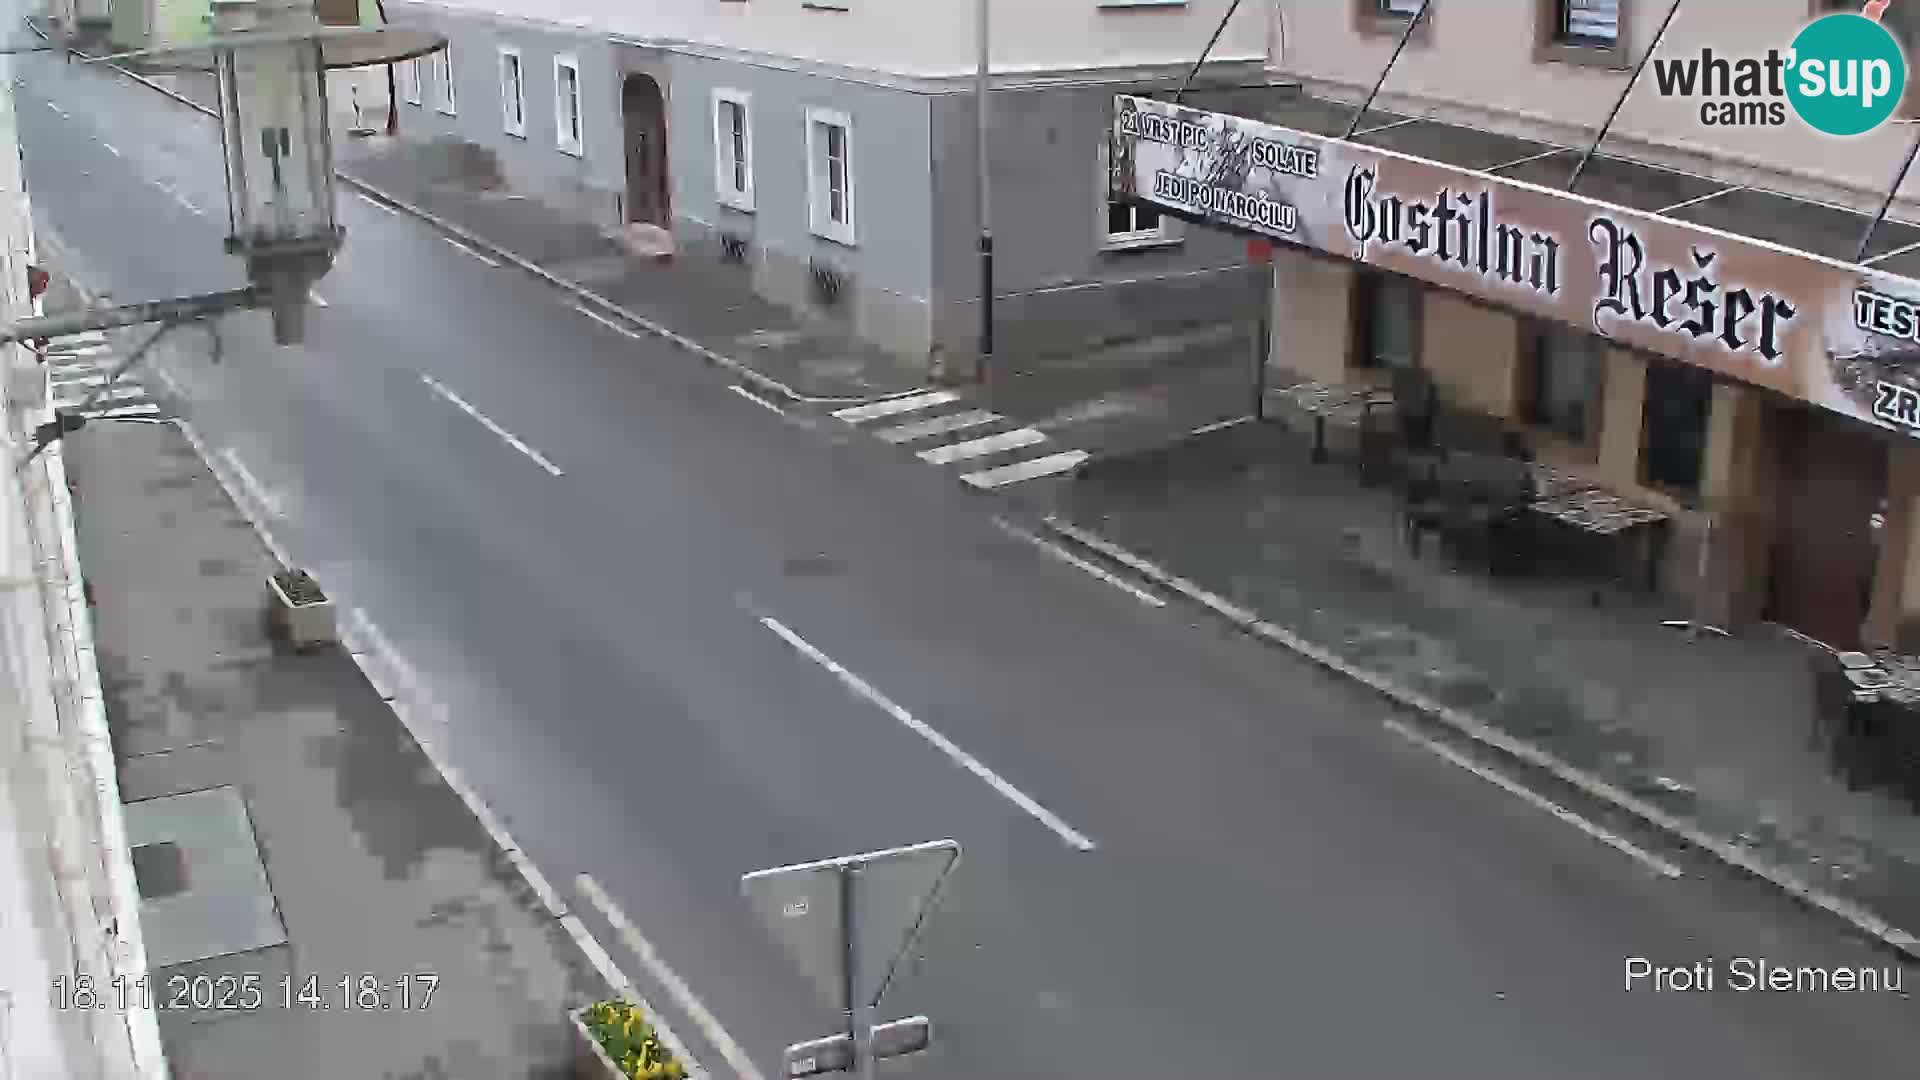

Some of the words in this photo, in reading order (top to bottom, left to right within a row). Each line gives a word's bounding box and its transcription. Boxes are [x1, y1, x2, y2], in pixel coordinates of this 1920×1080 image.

[1143, 113, 1180, 144] VRST
[1253, 138, 1318, 178] SOLATE
[1154, 171, 1187, 203] JEDI
[1188, 181, 1212, 209] PO
[1213, 188, 1297, 232] NAROČILU
[1344, 163, 1562, 298] Gostilna
[1588, 216, 1797, 364] Rešer
